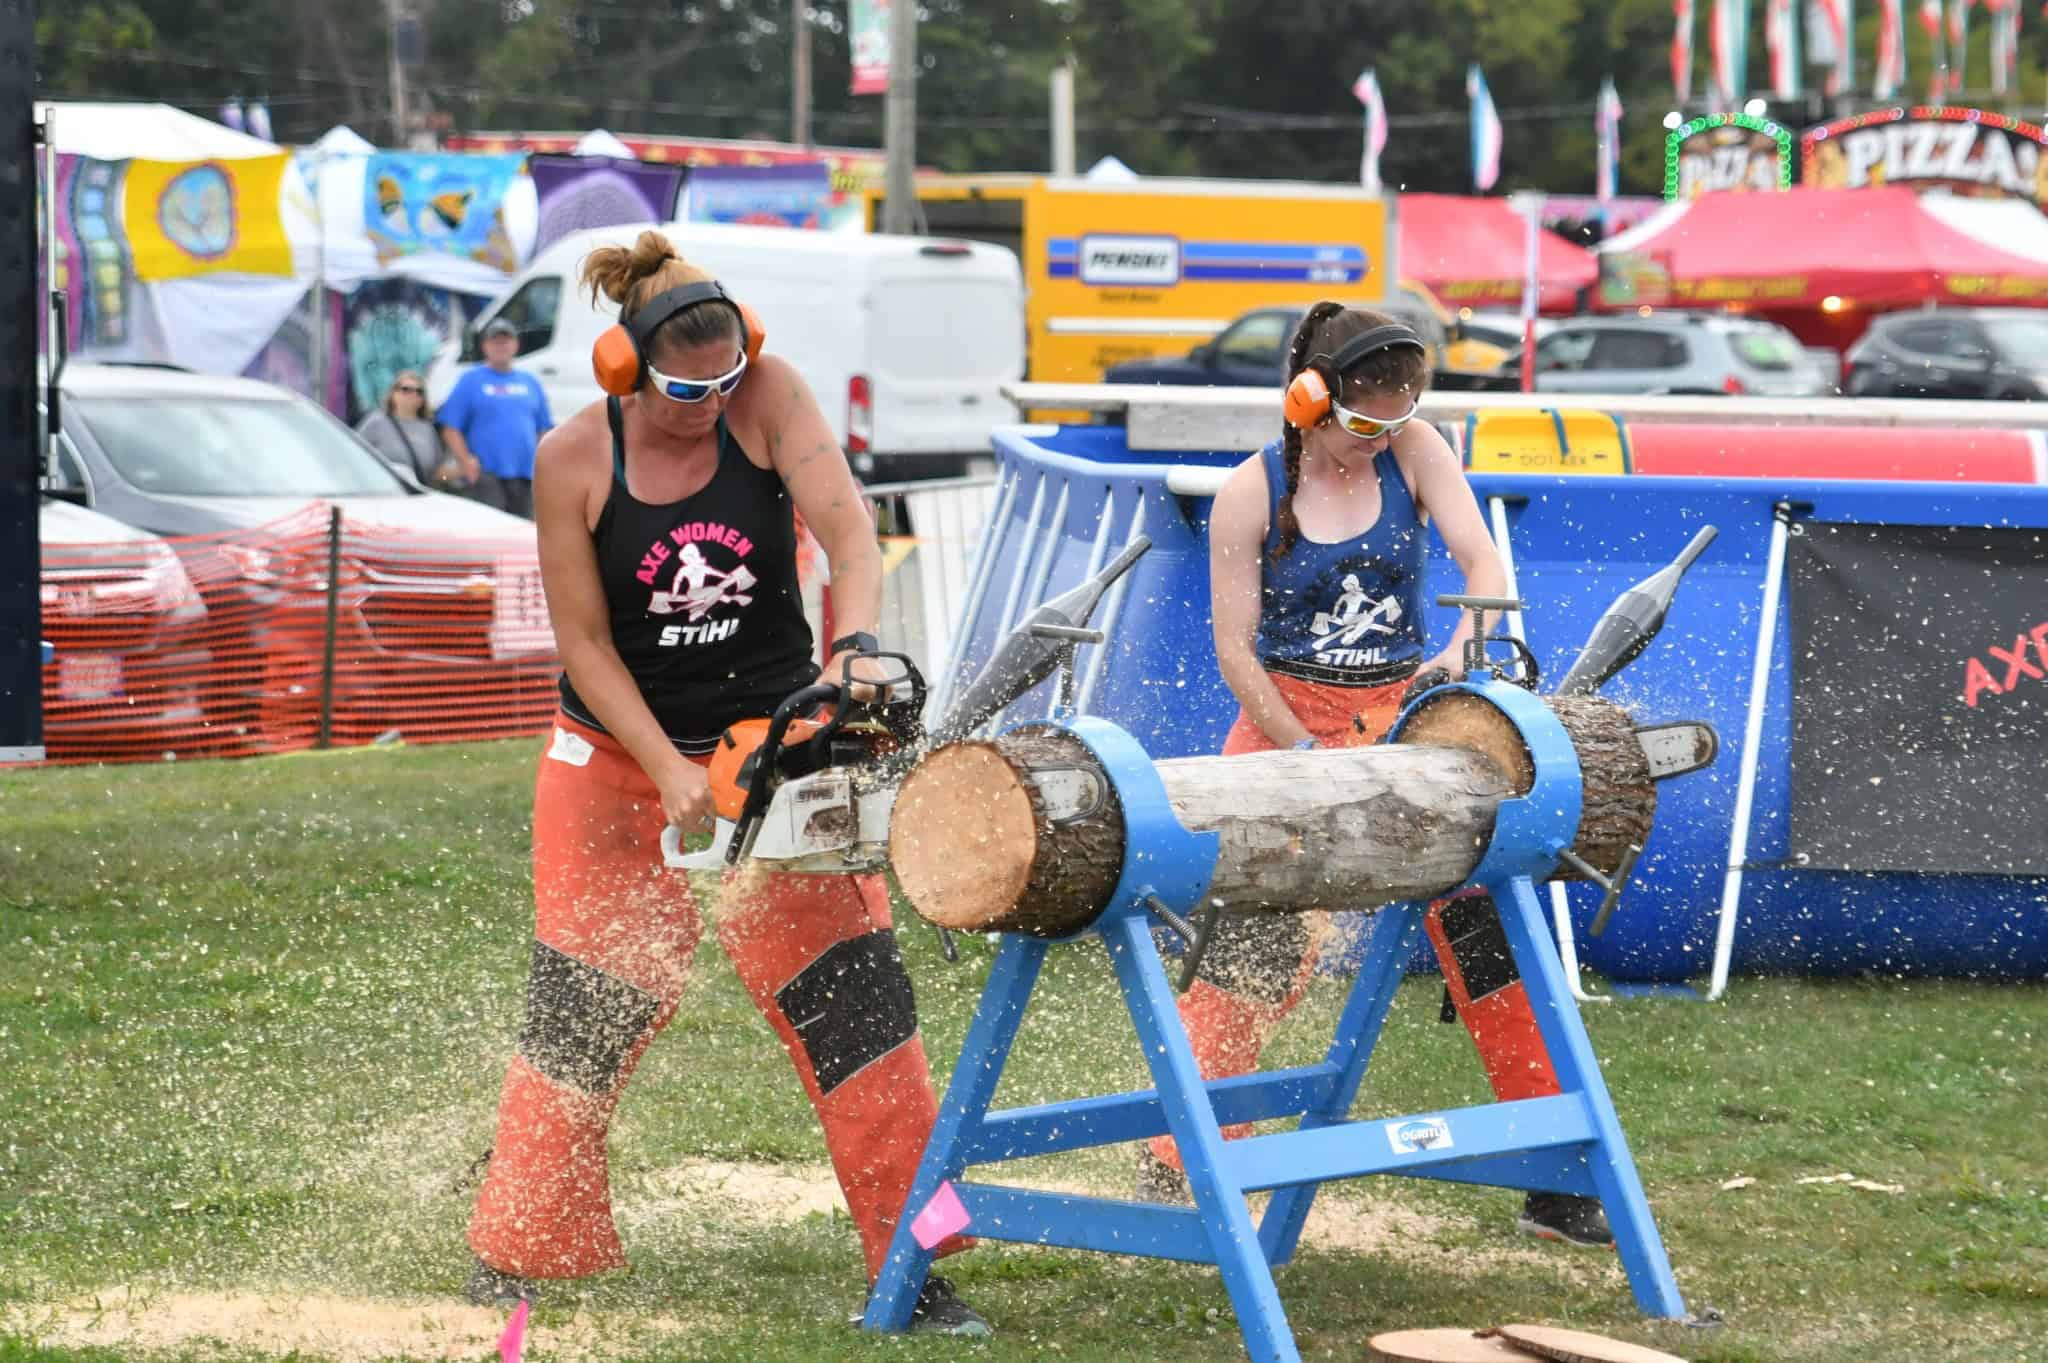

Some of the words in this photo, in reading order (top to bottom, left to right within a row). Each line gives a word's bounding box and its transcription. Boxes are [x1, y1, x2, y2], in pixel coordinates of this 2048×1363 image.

[1843, 121, 2039, 196] PIZZA!
[636, 540, 672, 585] AXE
[669, 522, 754, 559] WOMEN
[1314, 646, 1388, 666] STIHL
